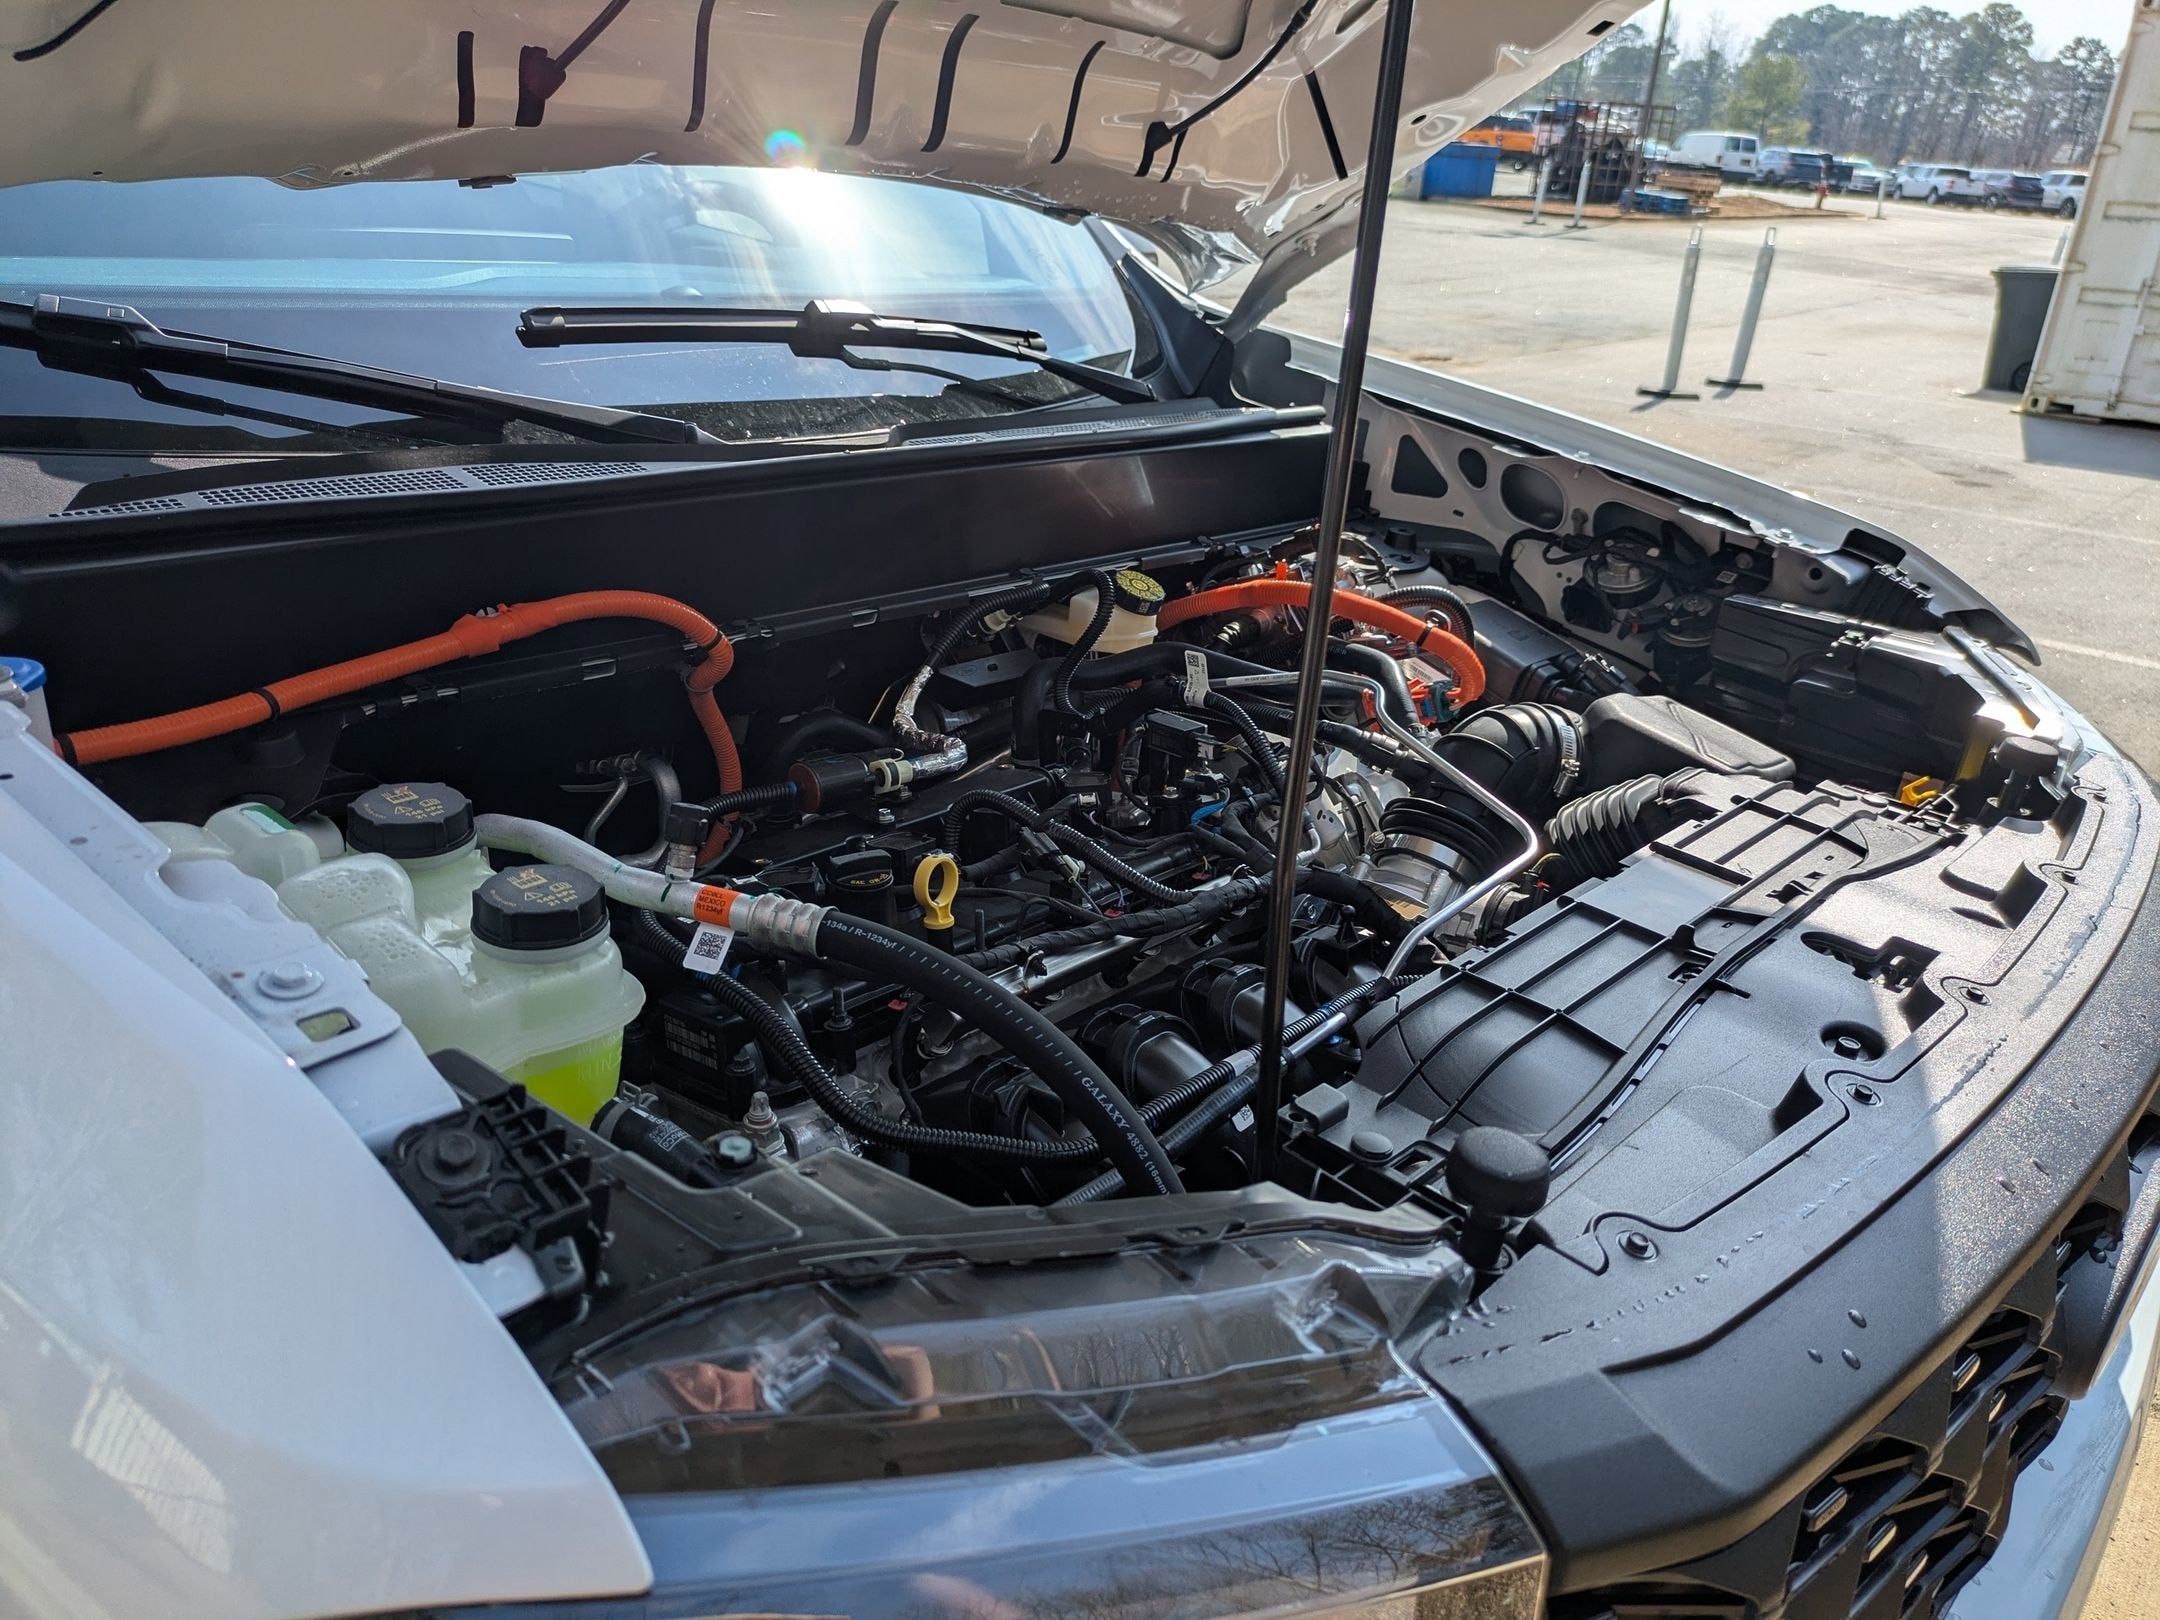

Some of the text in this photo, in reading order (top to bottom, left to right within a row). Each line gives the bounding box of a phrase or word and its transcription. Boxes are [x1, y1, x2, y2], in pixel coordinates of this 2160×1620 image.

[696, 902, 723, 916] R1234yf
[698, 895, 726, 907] MEXICO
[822, 919, 848, 932] -134a
[854, 928, 898, 949] R-1234yf
[1081, 1076, 1130, 1129] GALAXY
[1126, 1132, 1149, 1161] 4882
